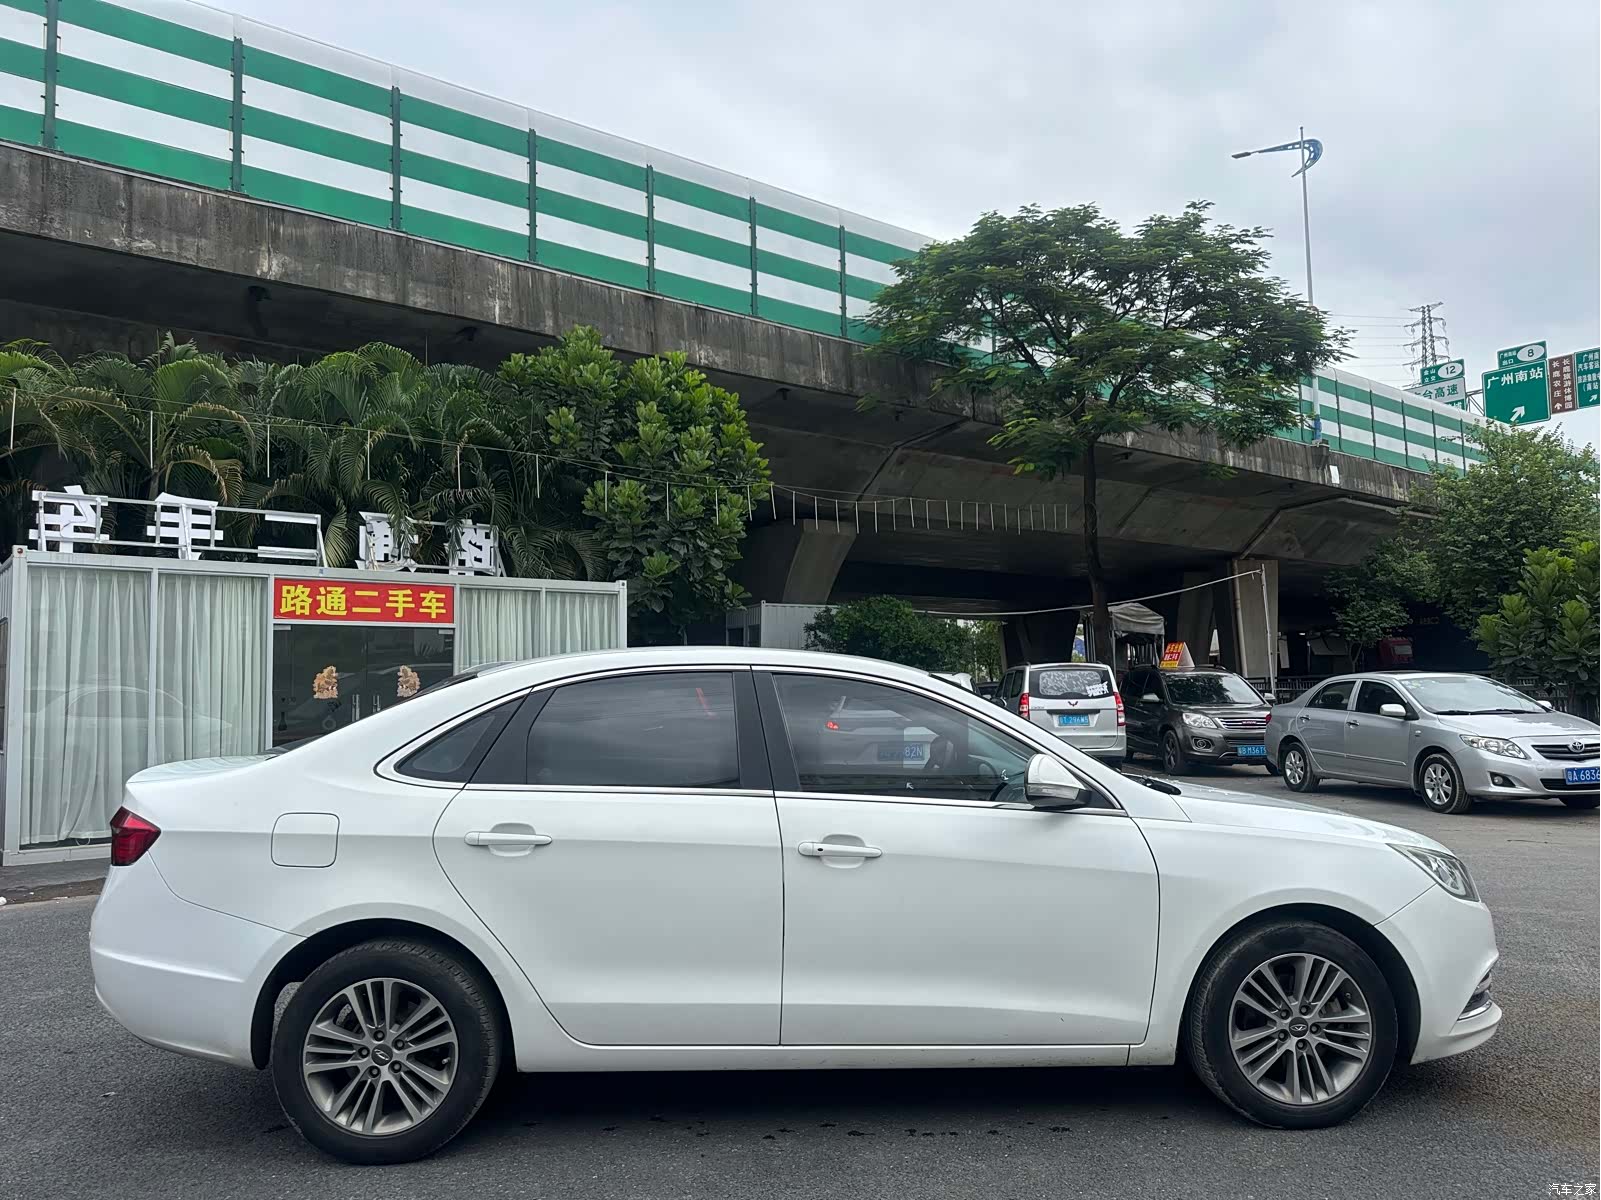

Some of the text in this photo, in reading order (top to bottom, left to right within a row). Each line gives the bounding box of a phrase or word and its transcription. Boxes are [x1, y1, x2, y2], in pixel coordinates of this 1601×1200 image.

[1527, 348, 1534, 358] 8
[1445, 365, 1456, 375] 12
[1487, 367, 1544, 389] 广州南站
[1414, 383, 1459, 400] 台高速
[280, 584, 446, 619] 路通二手车
